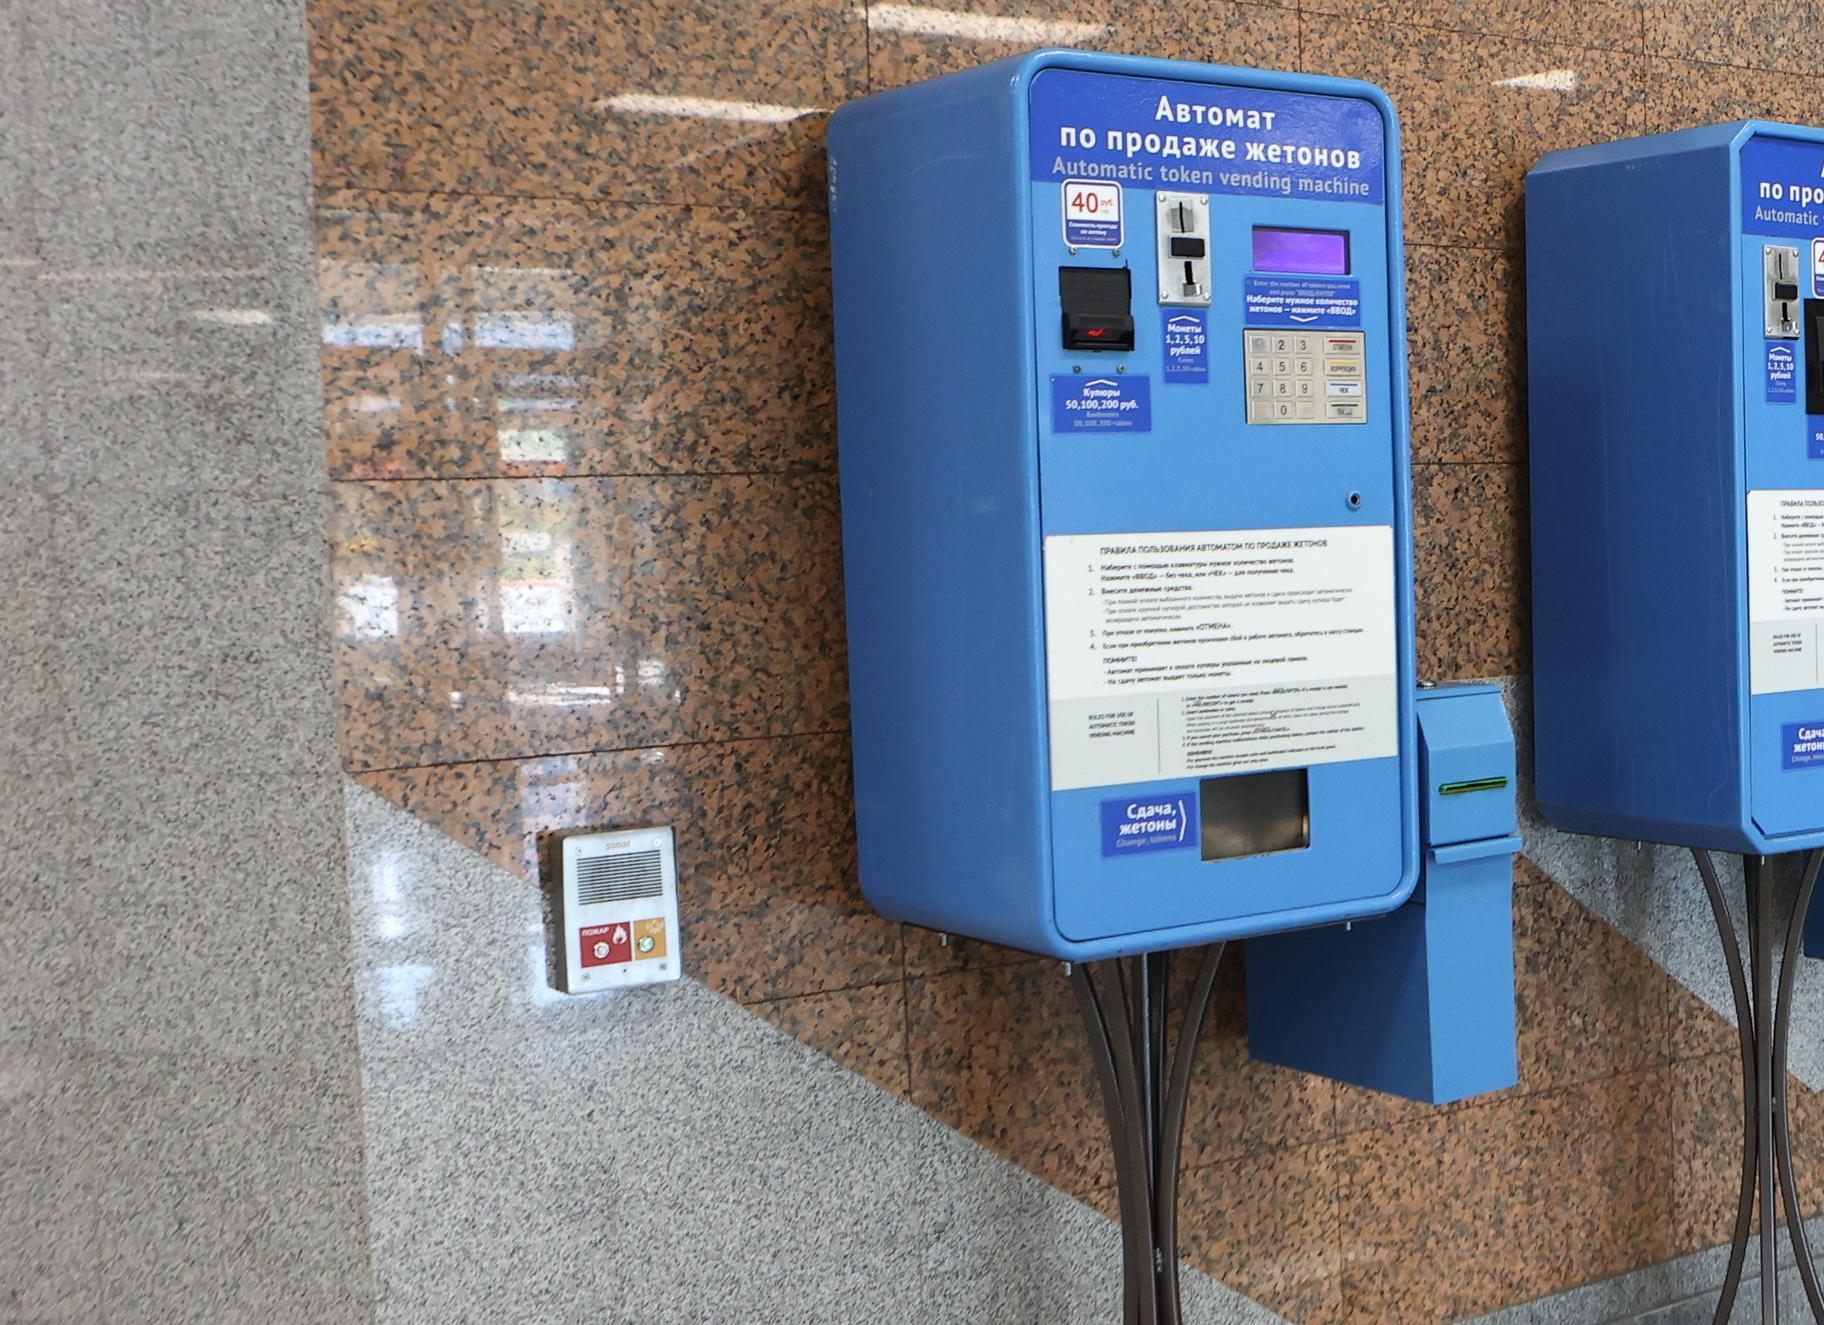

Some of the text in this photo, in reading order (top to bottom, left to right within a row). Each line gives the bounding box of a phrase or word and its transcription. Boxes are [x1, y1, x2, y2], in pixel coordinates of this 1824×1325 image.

[1155, 95, 1275, 130] Автомат
[1060, 126, 1361, 170] по продаже жетонов
[1052, 156, 1370, 196] Automatic token vending machine
[1760, 182, 1783, 200] по
[1072, 192, 1098, 213] 40
[1755, 206, 1818, 226] Automatic
[1246, 294, 1358, 307] Наберите нужное количество
[1167, 324, 1202, 333] Монеты
[1170, 344, 1200, 356] рублей
[1278, 340, 1306, 351] 2 3
[1256, 360, 1308, 372] 4 5 6
[1082, 388, 1120, 398] Купюры
[1257, 383, 1308, 394] 7 8 9
[1120, 400, 1140, 411] руб.
[1280, 405, 1288, 416] 0
[1100, 546, 1136, 555] ПРАВИЛА
[1138, 544, 1195, 554] ПОЛЬЗОВАНИЯ
[1196, 542, 1243, 552] АВТОМАТОМ
[1256, 541, 1292, 550] ПРОДАЖЕ
[1294, 539, 1328, 548] ЖЕТОНОВ
[1126, 803, 1176, 820] Сдача,
[1119, 818, 1176, 836] жетоны
